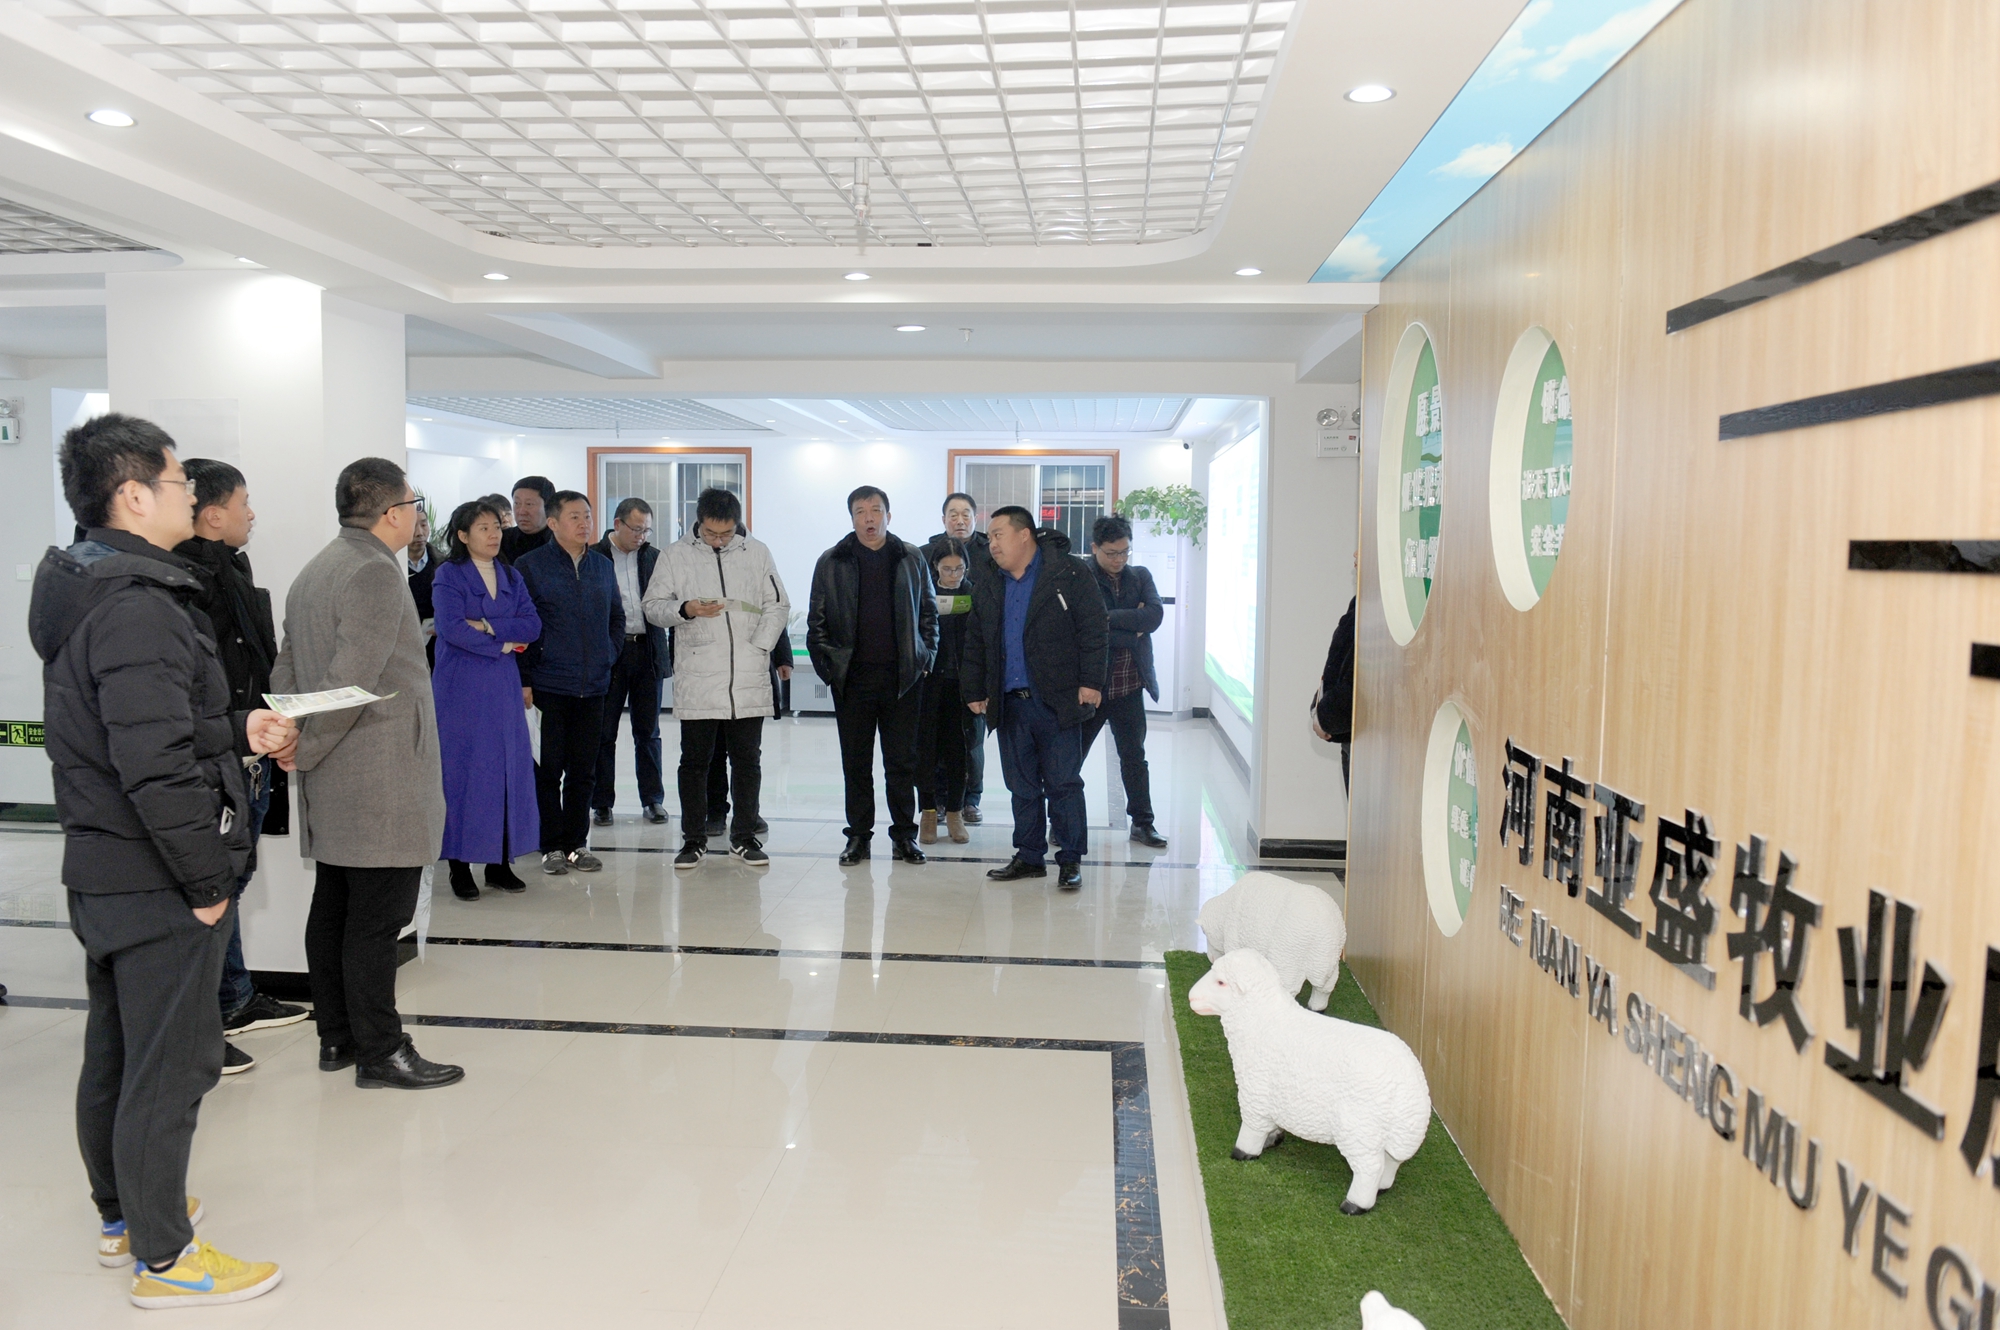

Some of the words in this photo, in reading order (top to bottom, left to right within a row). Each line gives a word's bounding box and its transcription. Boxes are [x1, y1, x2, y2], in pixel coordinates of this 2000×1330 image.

[1416, 385, 1441, 437] 愿景
[1500, 735, 2000, 1189] 河南亚盛牧业
[1500, 884, 1524, 947] HE
[1529, 908, 1582, 998] NAN
[1585, 953, 1618, 1036] YA
[1624, 991, 1739, 1142] SHENG
[1743, 1086, 1824, 1211] MU
[1836, 1159, 1913, 1300] YE
